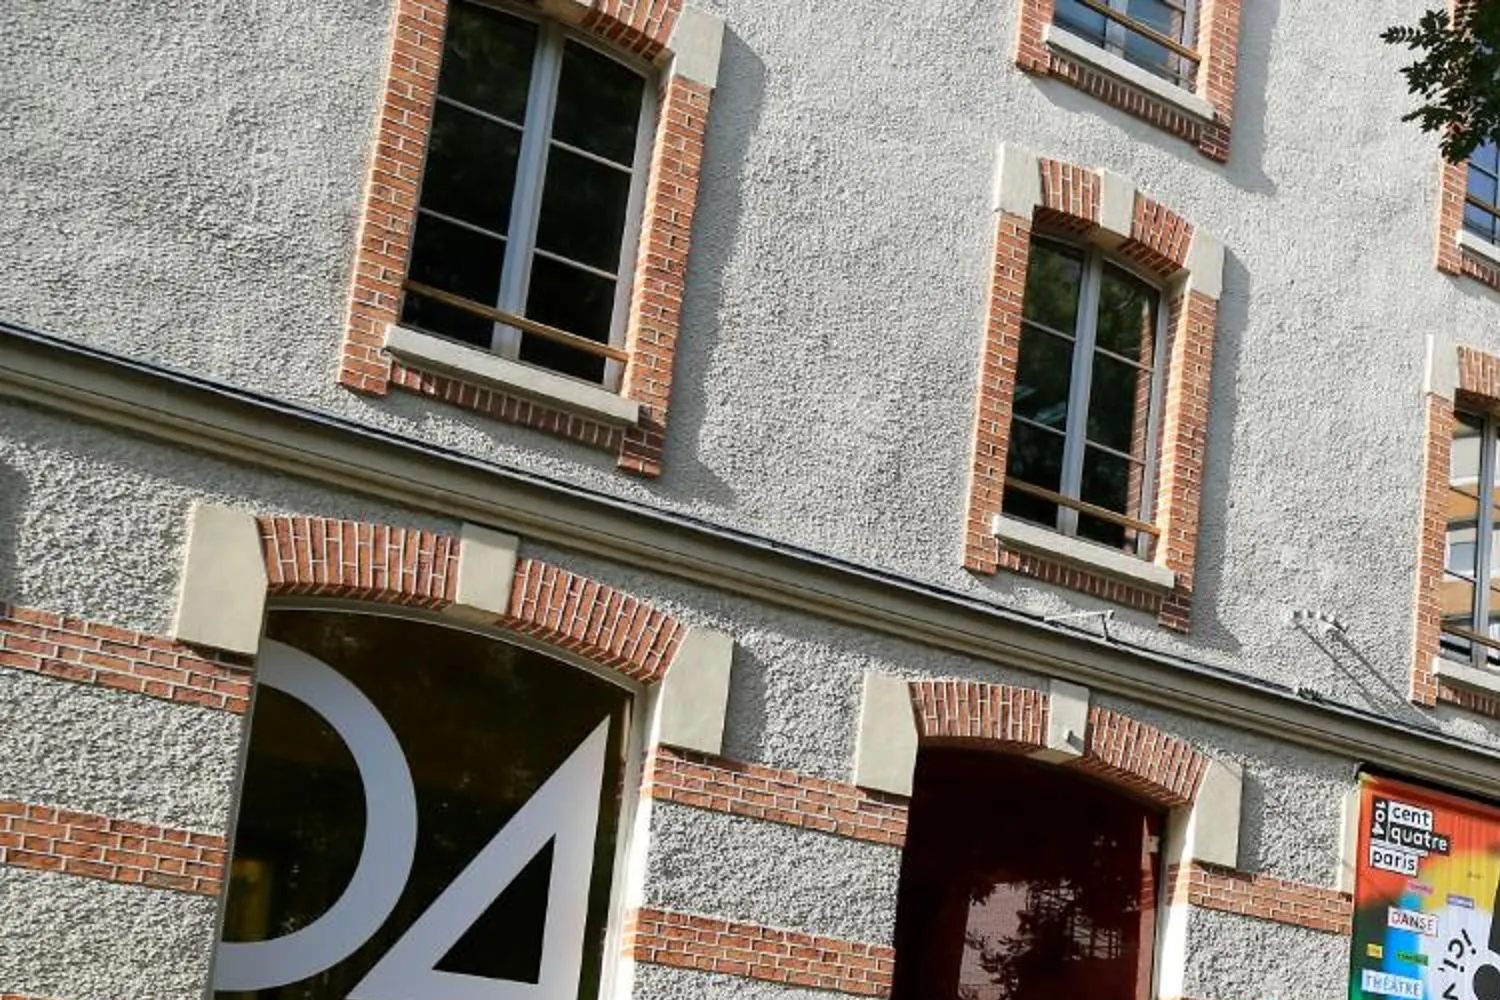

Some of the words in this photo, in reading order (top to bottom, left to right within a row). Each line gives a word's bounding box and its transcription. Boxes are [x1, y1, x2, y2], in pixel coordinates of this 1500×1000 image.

[1392, 806, 1430, 827] cent
[1391, 827, 1448, 851] quatre
[1373, 851, 1415, 871] paris
[1391, 911, 1435, 931] DANSE
